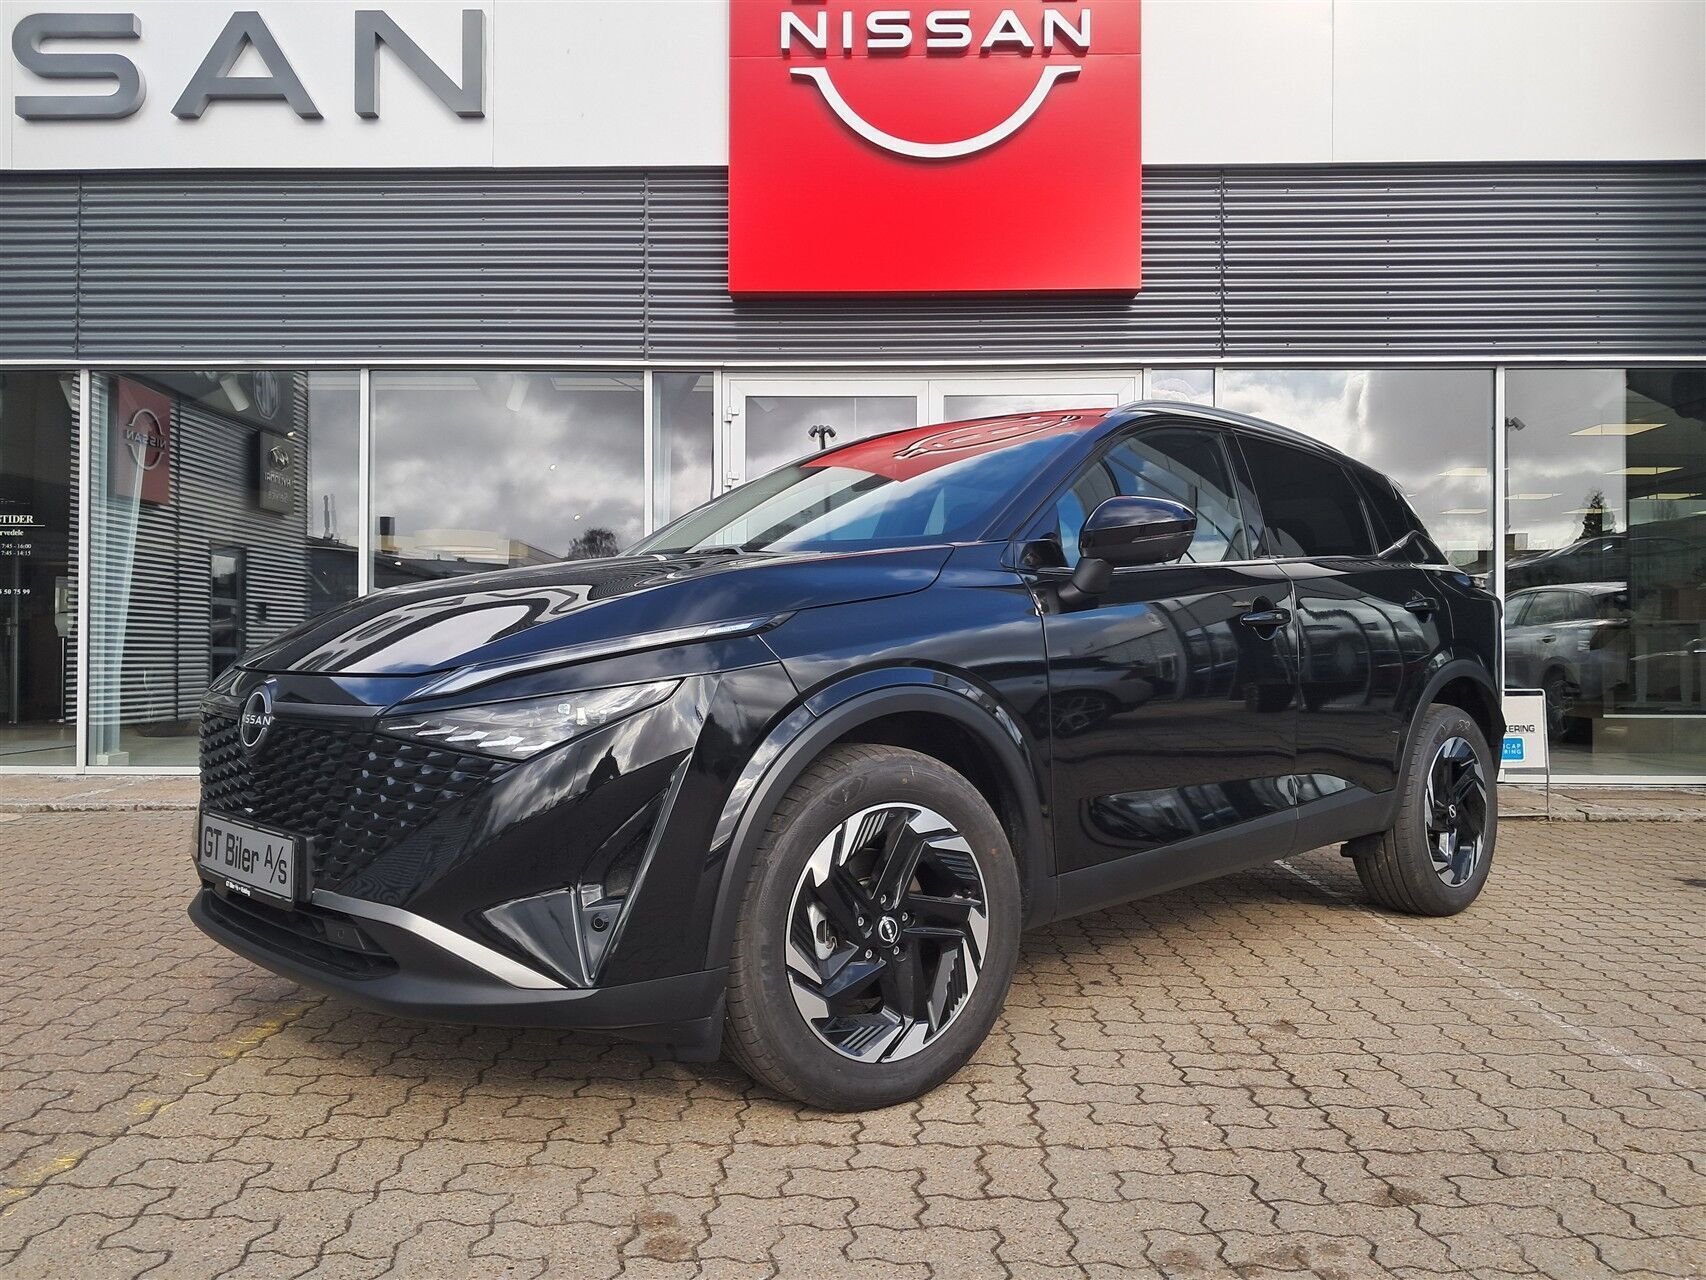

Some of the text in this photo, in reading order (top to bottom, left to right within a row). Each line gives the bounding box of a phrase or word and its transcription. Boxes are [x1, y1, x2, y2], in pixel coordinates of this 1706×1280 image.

[780, 8, 1091, 56] NISSAN
[12, 9, 486, 122] SAN
[204, 826, 222, 860] GT
[225, 832, 259, 874] Biler
